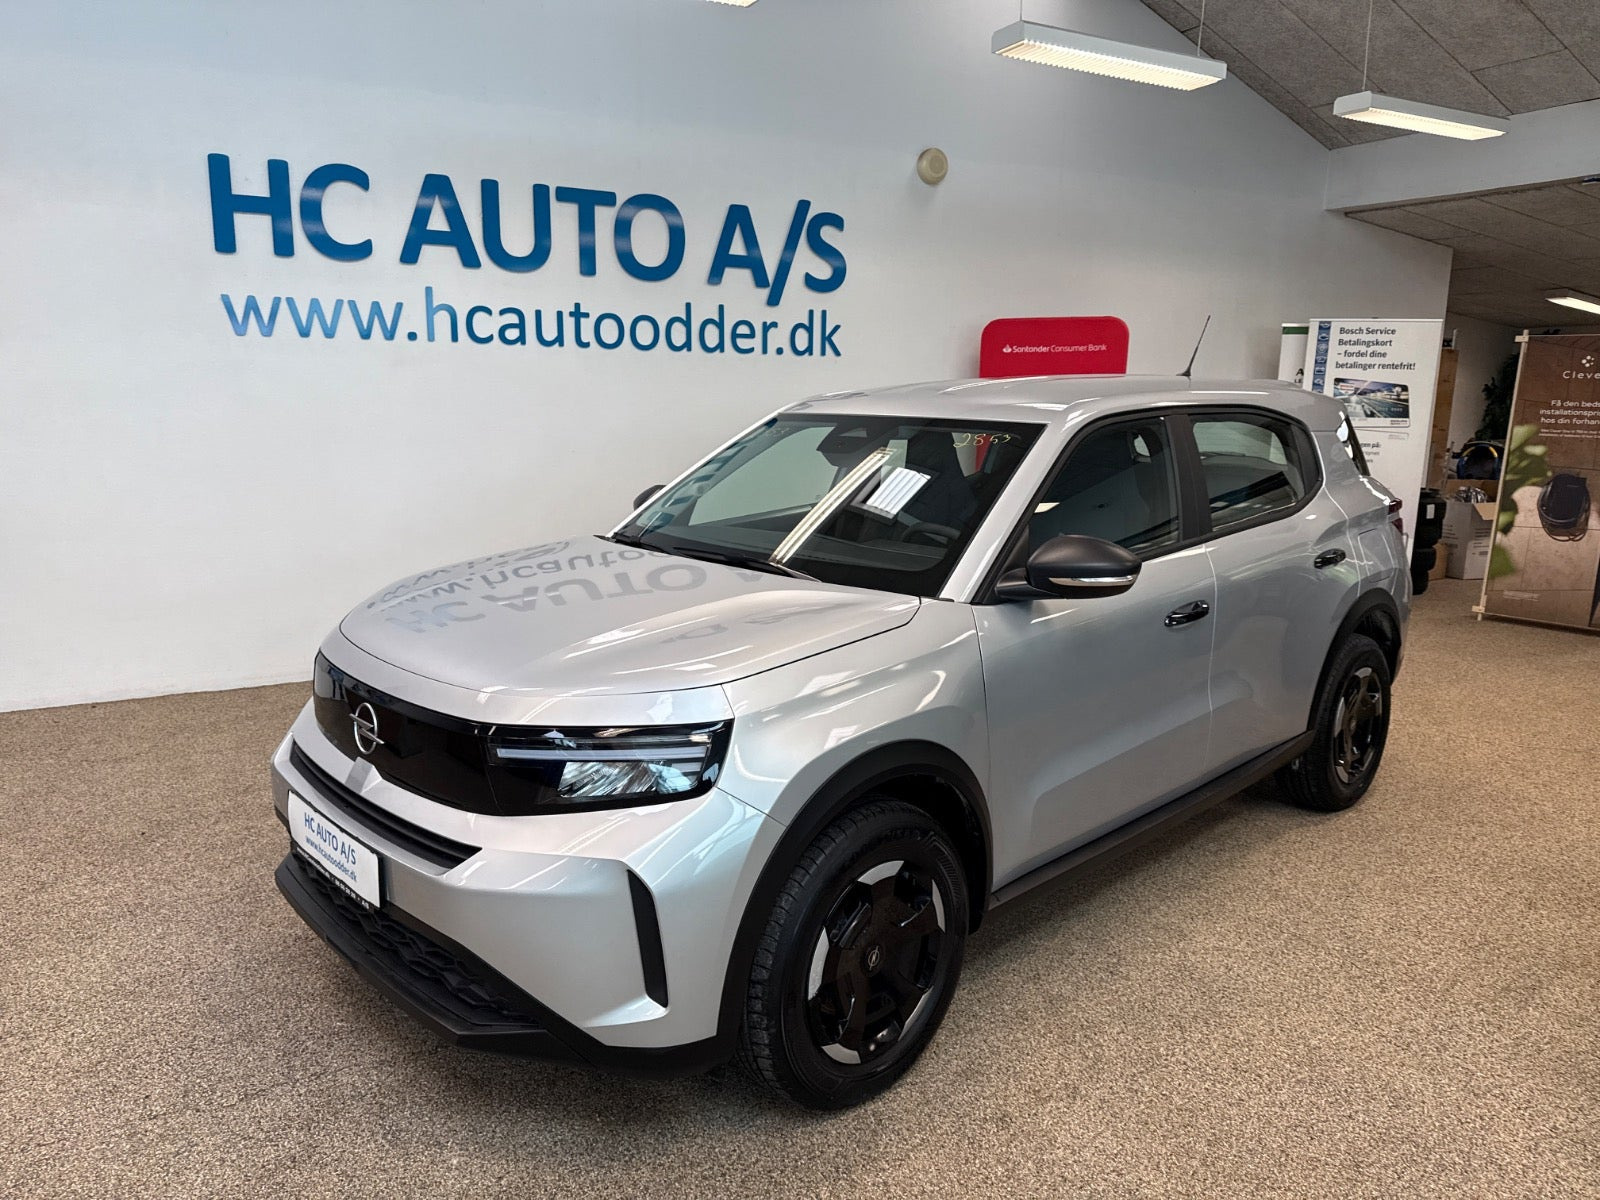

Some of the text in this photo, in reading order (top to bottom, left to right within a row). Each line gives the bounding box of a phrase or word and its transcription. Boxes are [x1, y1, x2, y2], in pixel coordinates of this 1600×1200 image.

[207, 153, 847, 306] HC AUTO A/S
[221, 286, 843, 357] www.hcautoodder.dk
[1339, 327, 1397, 335] Bosch Service
[1013, 343, 1107, 353] Santander Consumer Bank
[1337, 338, 1393, 348] Betalingskort
[1343, 350, 1368, 358] fordel
[1369, 350, 1387, 358] dine
[1335, 361, 1416, 371] betalinger rentefrit!
[1562, 370, 1600, 379] Cleve
[1551, 399, 1561, 407] Få
[1541, 416, 1556, 424] hos
[304, 812, 315, 833] HC
[317, 823, 339, 851] AUTO
[341, 842, 357, 865] A/S
